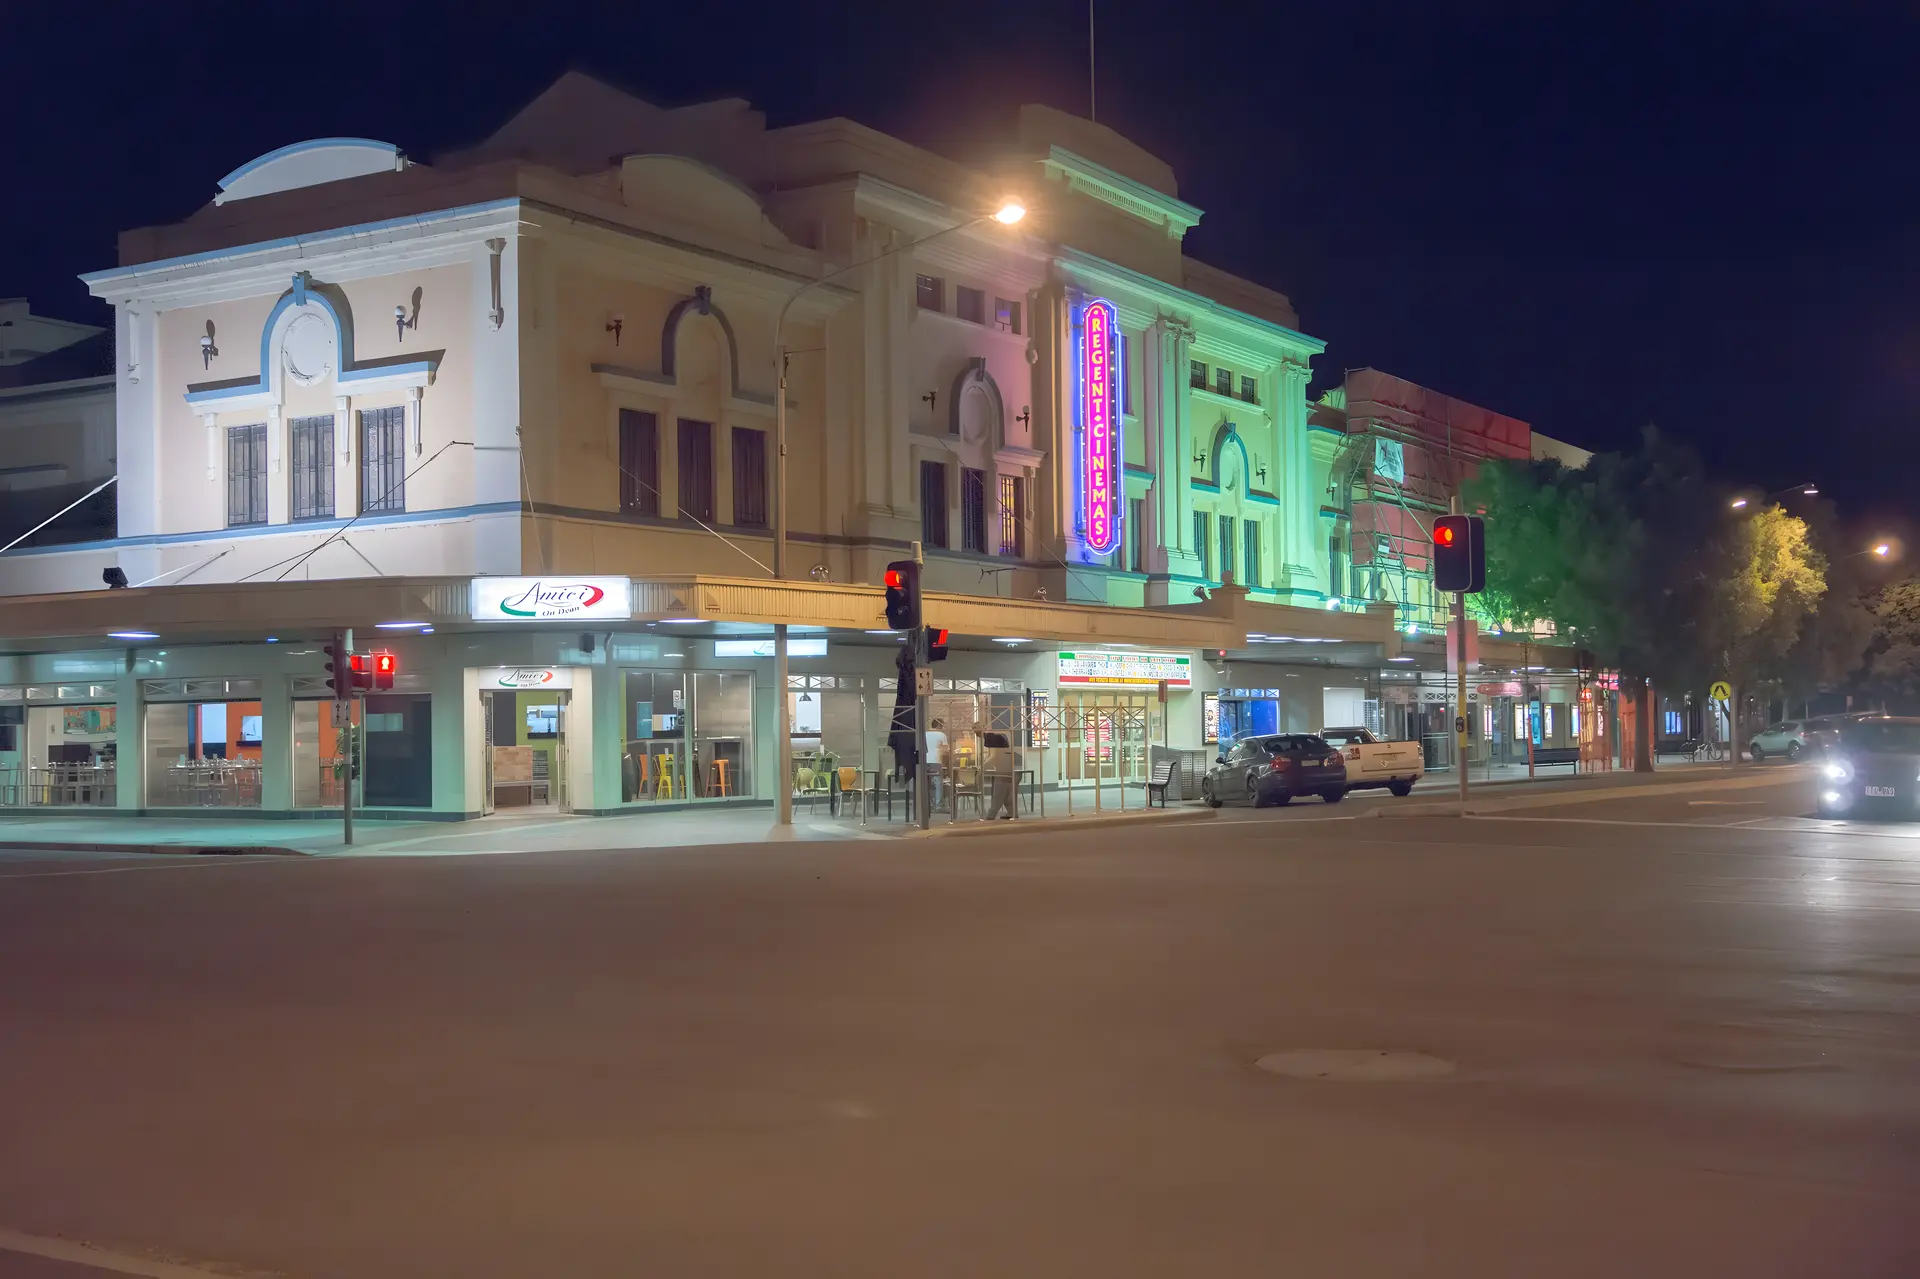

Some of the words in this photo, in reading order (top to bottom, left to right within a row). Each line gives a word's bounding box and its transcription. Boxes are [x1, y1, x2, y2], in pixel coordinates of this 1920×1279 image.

[1091, 317, 1105, 414] REGENT
[1093, 423, 1106, 536] CINEMAS
[506, 581, 588, 607] Amici
[558, 605, 580, 616] Dean
[503, 668, 544, 682] Amici
